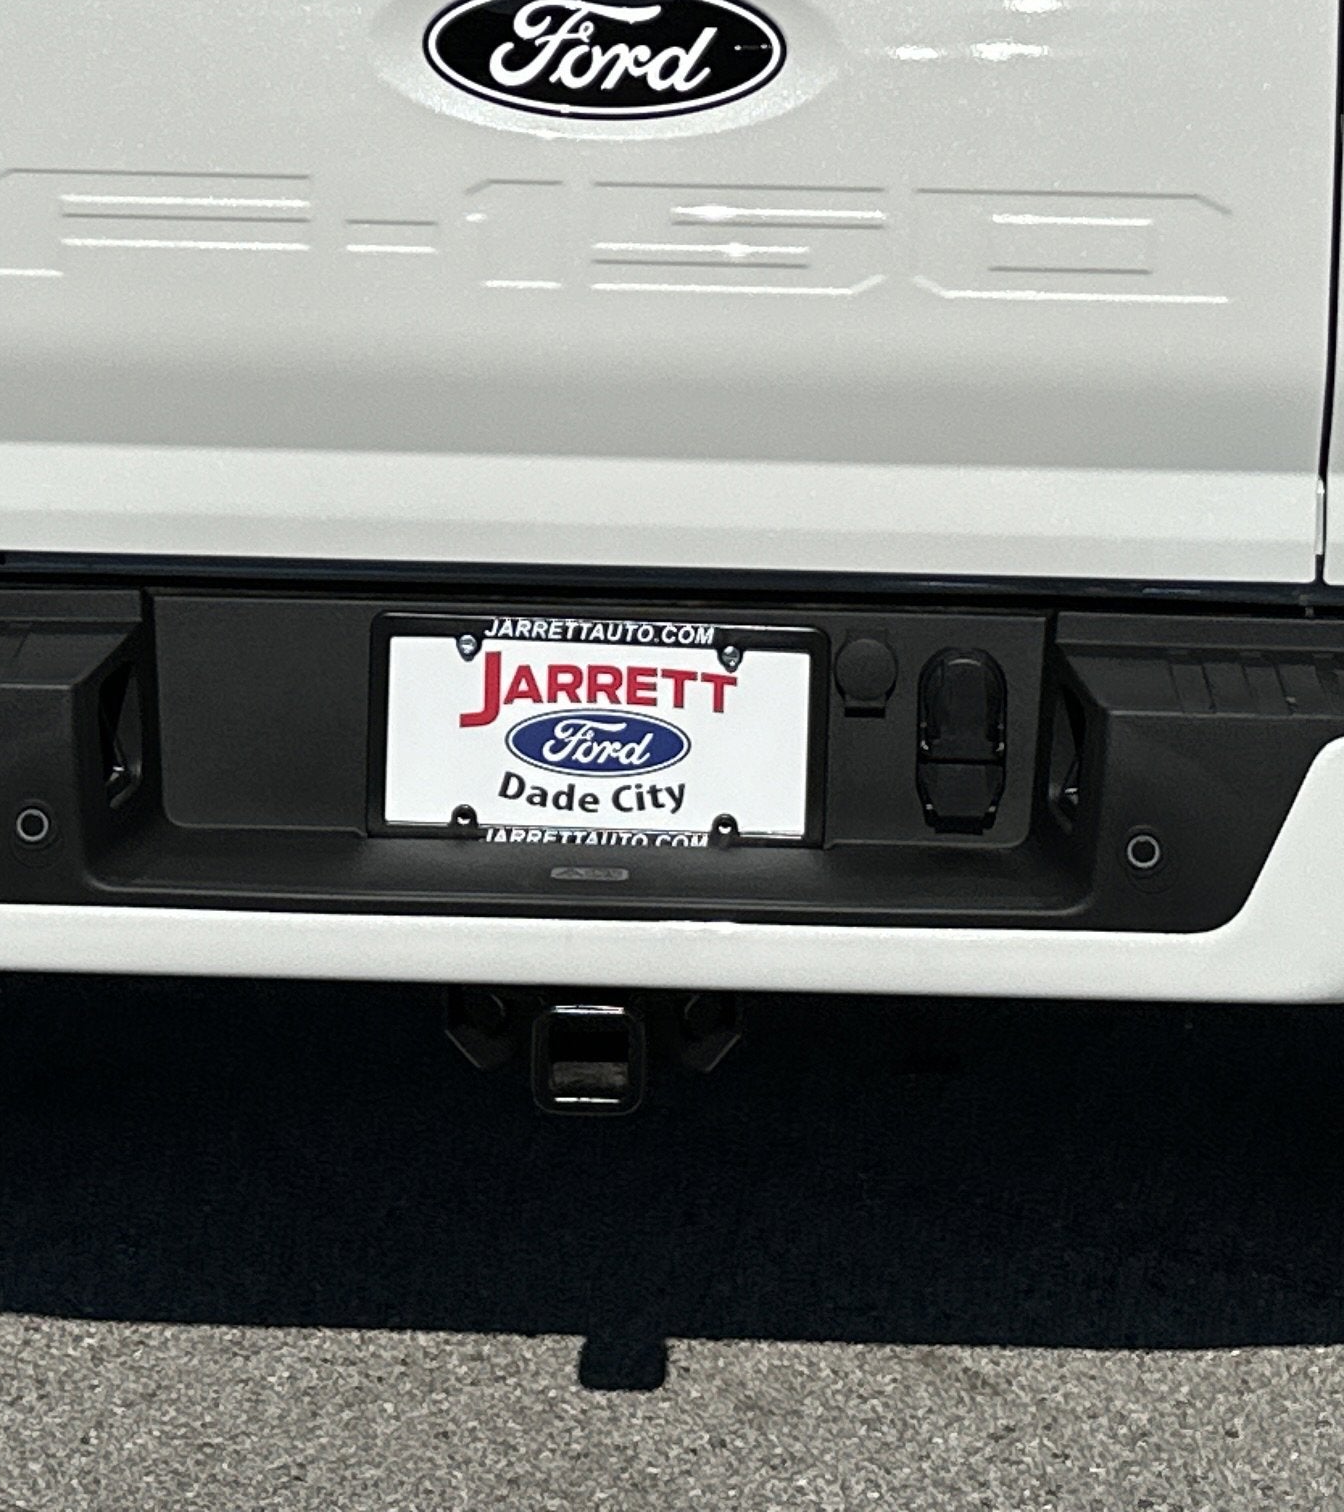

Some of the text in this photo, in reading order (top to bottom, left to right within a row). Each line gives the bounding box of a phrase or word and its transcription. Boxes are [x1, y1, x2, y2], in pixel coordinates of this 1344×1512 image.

[484, 617, 715, 645] JARRETTAUTO.COM
[459, 651, 738, 728] JARRETT
[542, 719, 654, 765] Ford
[498, 771, 686, 814] Dade City
[485, 828, 709, 848] JARRETTAUTOCOM
